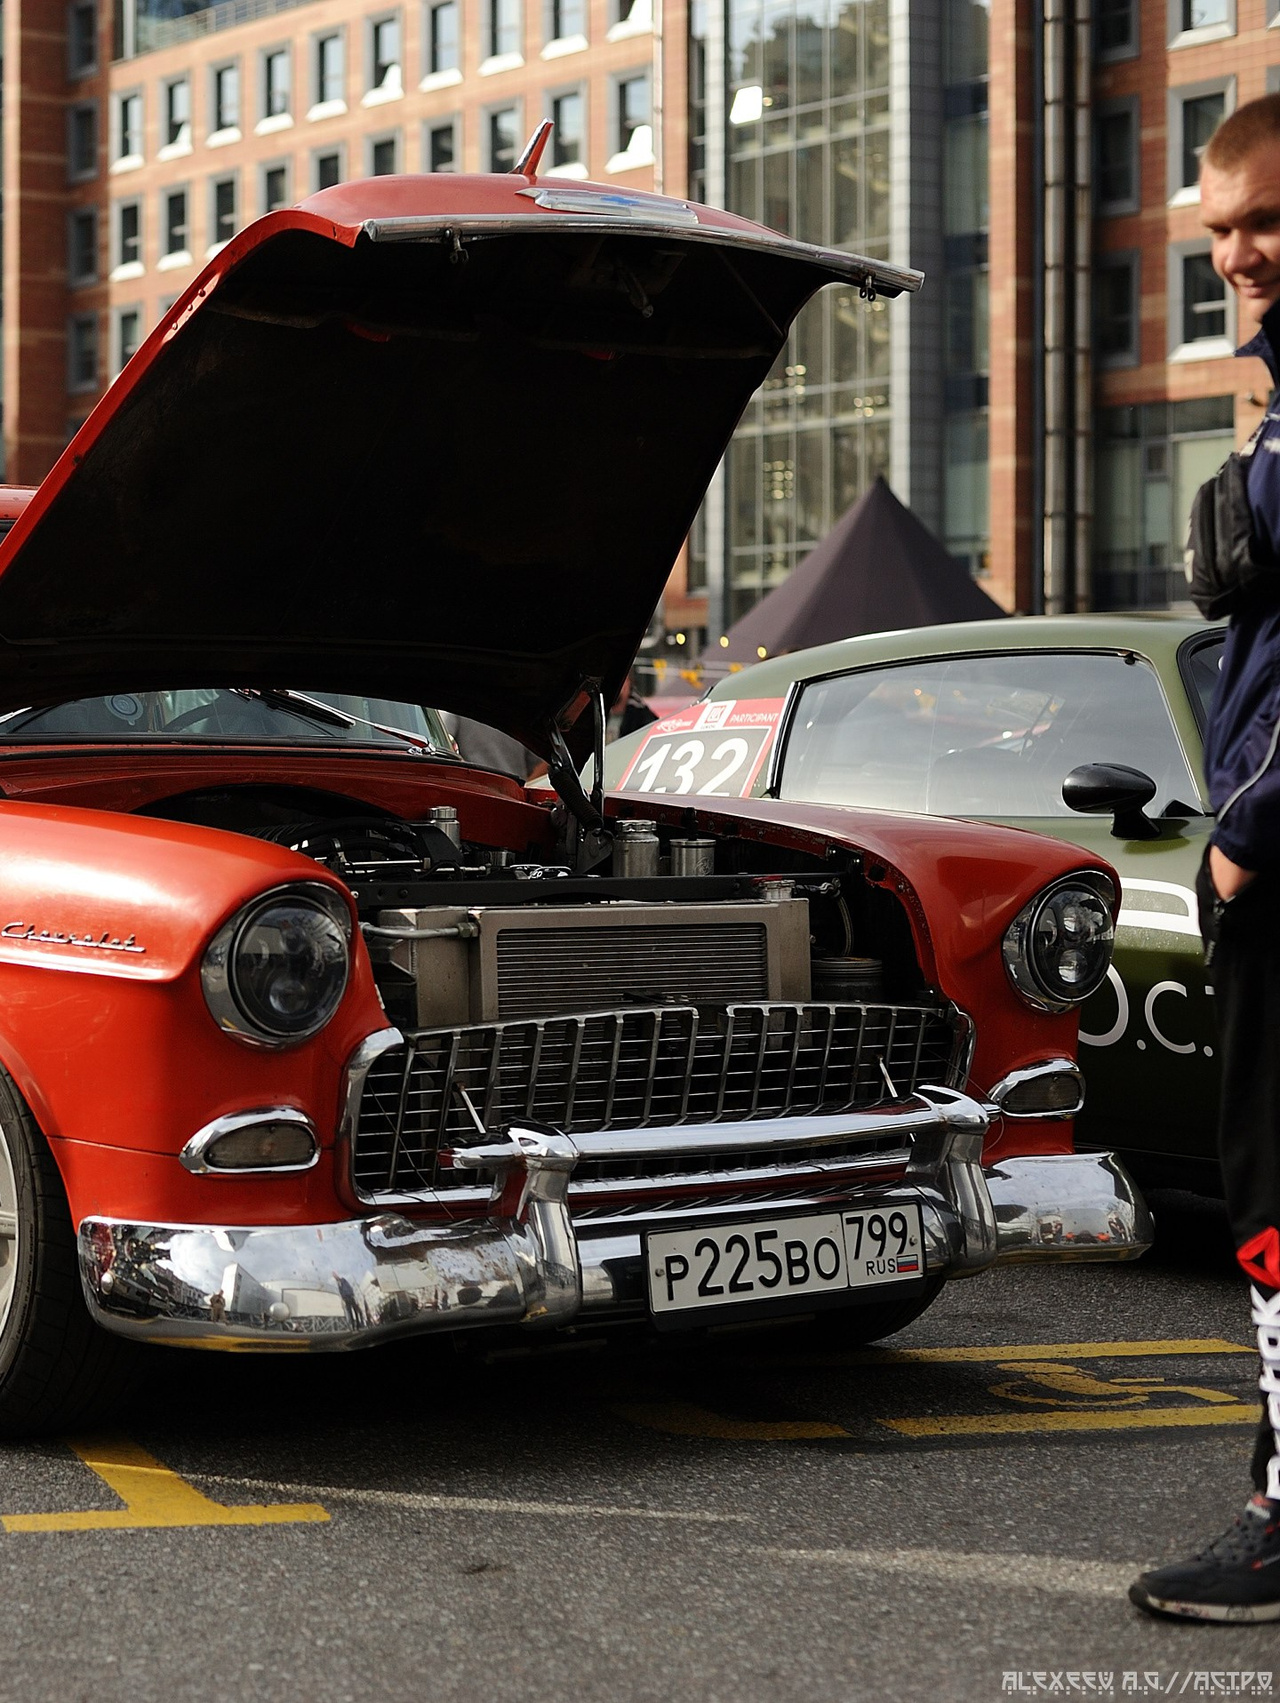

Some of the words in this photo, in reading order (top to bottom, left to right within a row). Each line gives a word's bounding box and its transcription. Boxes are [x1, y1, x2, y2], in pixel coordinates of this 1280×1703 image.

[729, 711, 780, 724] PARTICIPANT
[637, 737, 749, 797] 132
[1, 921, 145, 953] Chevrolet
[846, 1211, 908, 1260] 799
[866, 1257, 896, 1276] RUS
